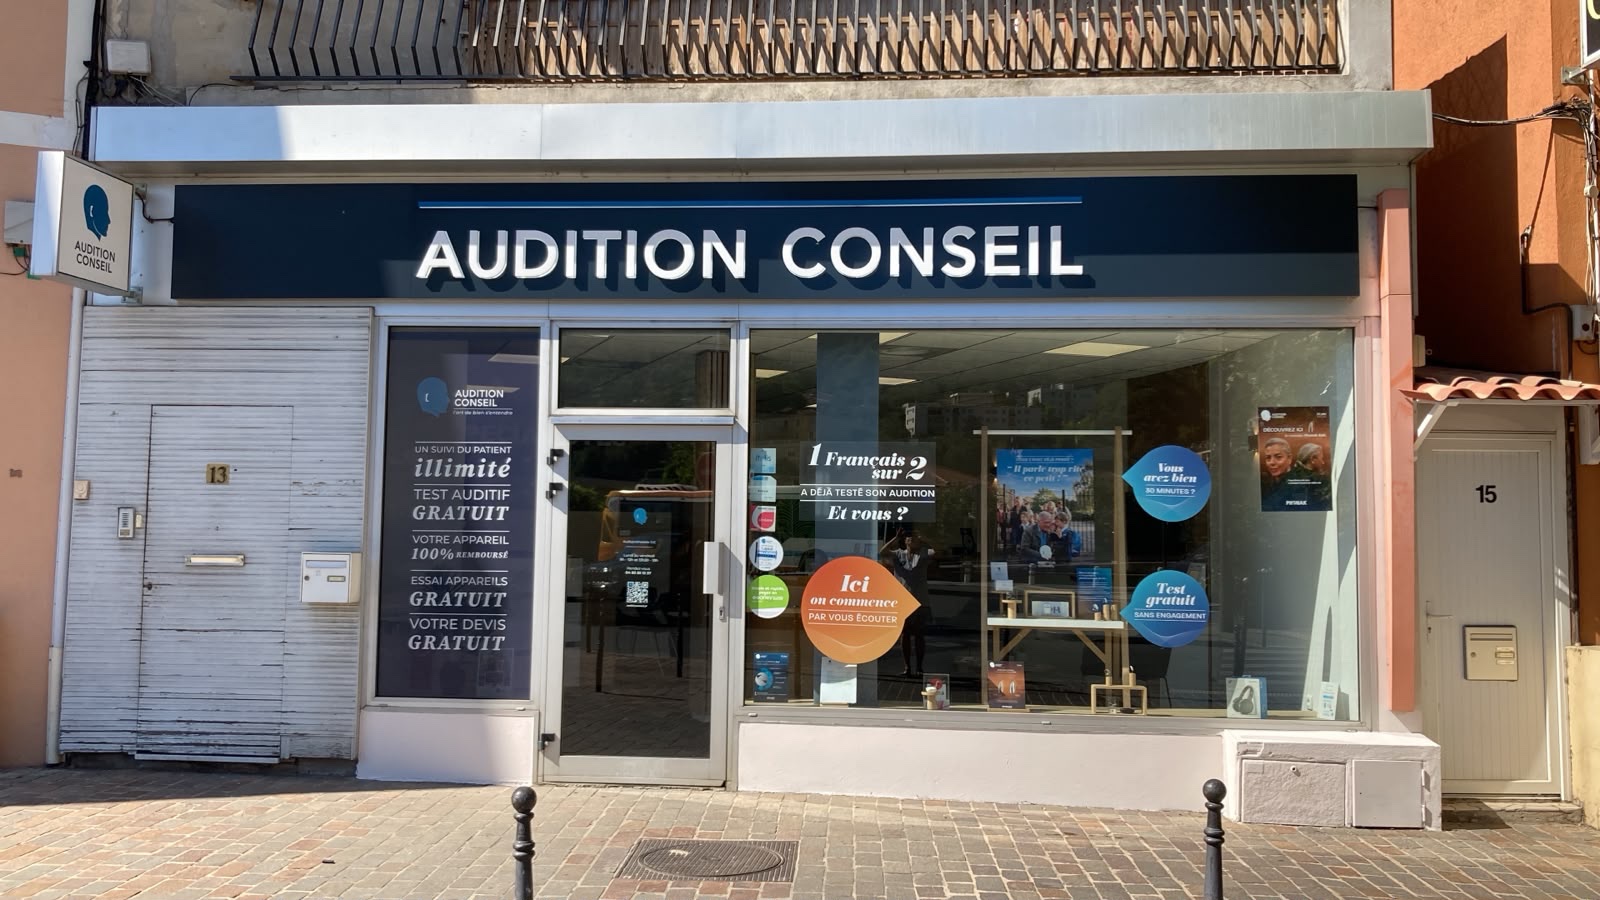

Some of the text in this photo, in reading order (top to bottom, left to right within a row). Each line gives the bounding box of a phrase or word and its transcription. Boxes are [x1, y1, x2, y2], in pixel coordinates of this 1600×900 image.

[75, 241, 116, 262] AUDITION
[416, 226, 1083, 279] AUDITION CONSEIL
[77, 254, 113, 273] CONSEIL
[455, 389, 504, 398] AUDITION
[454, 398, 499, 407] CONSEIL
[415, 446, 512, 455] UN SUIVI DU PATIENT
[808, 443, 906, 470] 1 Français
[415, 457, 512, 478] illimité
[872, 456, 927, 480] sur 2
[1158, 463, 1184, 473] Vous
[210, 466, 228, 484] 13
[1143, 473, 1197, 483] avez bien
[414, 489, 511, 501] TEST AUDITIF
[801, 486, 935, 498] A DÉJÀ TESTÉ SON AUDITION
[1145, 487, 1155, 495] 30
[1156, 487, 1189, 495] MINUTES
[1475, 485, 1497, 503] 15
[413, 505, 510, 521] GRATUIT
[826, 505, 909, 521] Et vous ?
[412, 535, 510, 545] VOTRE APPAREIL
[411, 547, 509, 560] 100% REMBOURSÉ
[411, 576, 509, 586] ESSAI APPAREILS
[840, 574, 870, 593] Ici
[1156, 582, 1186, 595] Test
[410, 591, 507, 607] GRATUIT
[810, 597, 898, 608] on commence
[1146, 595, 1196, 608] gratuit
[808, 613, 898, 624] PAR VOUS ÉCOUTER
[1156, 611, 1207, 620] ENGAGEMENT
[410, 618, 506, 630] VOTRE DEVIS
[408, 634, 505, 651] GRATUIT
